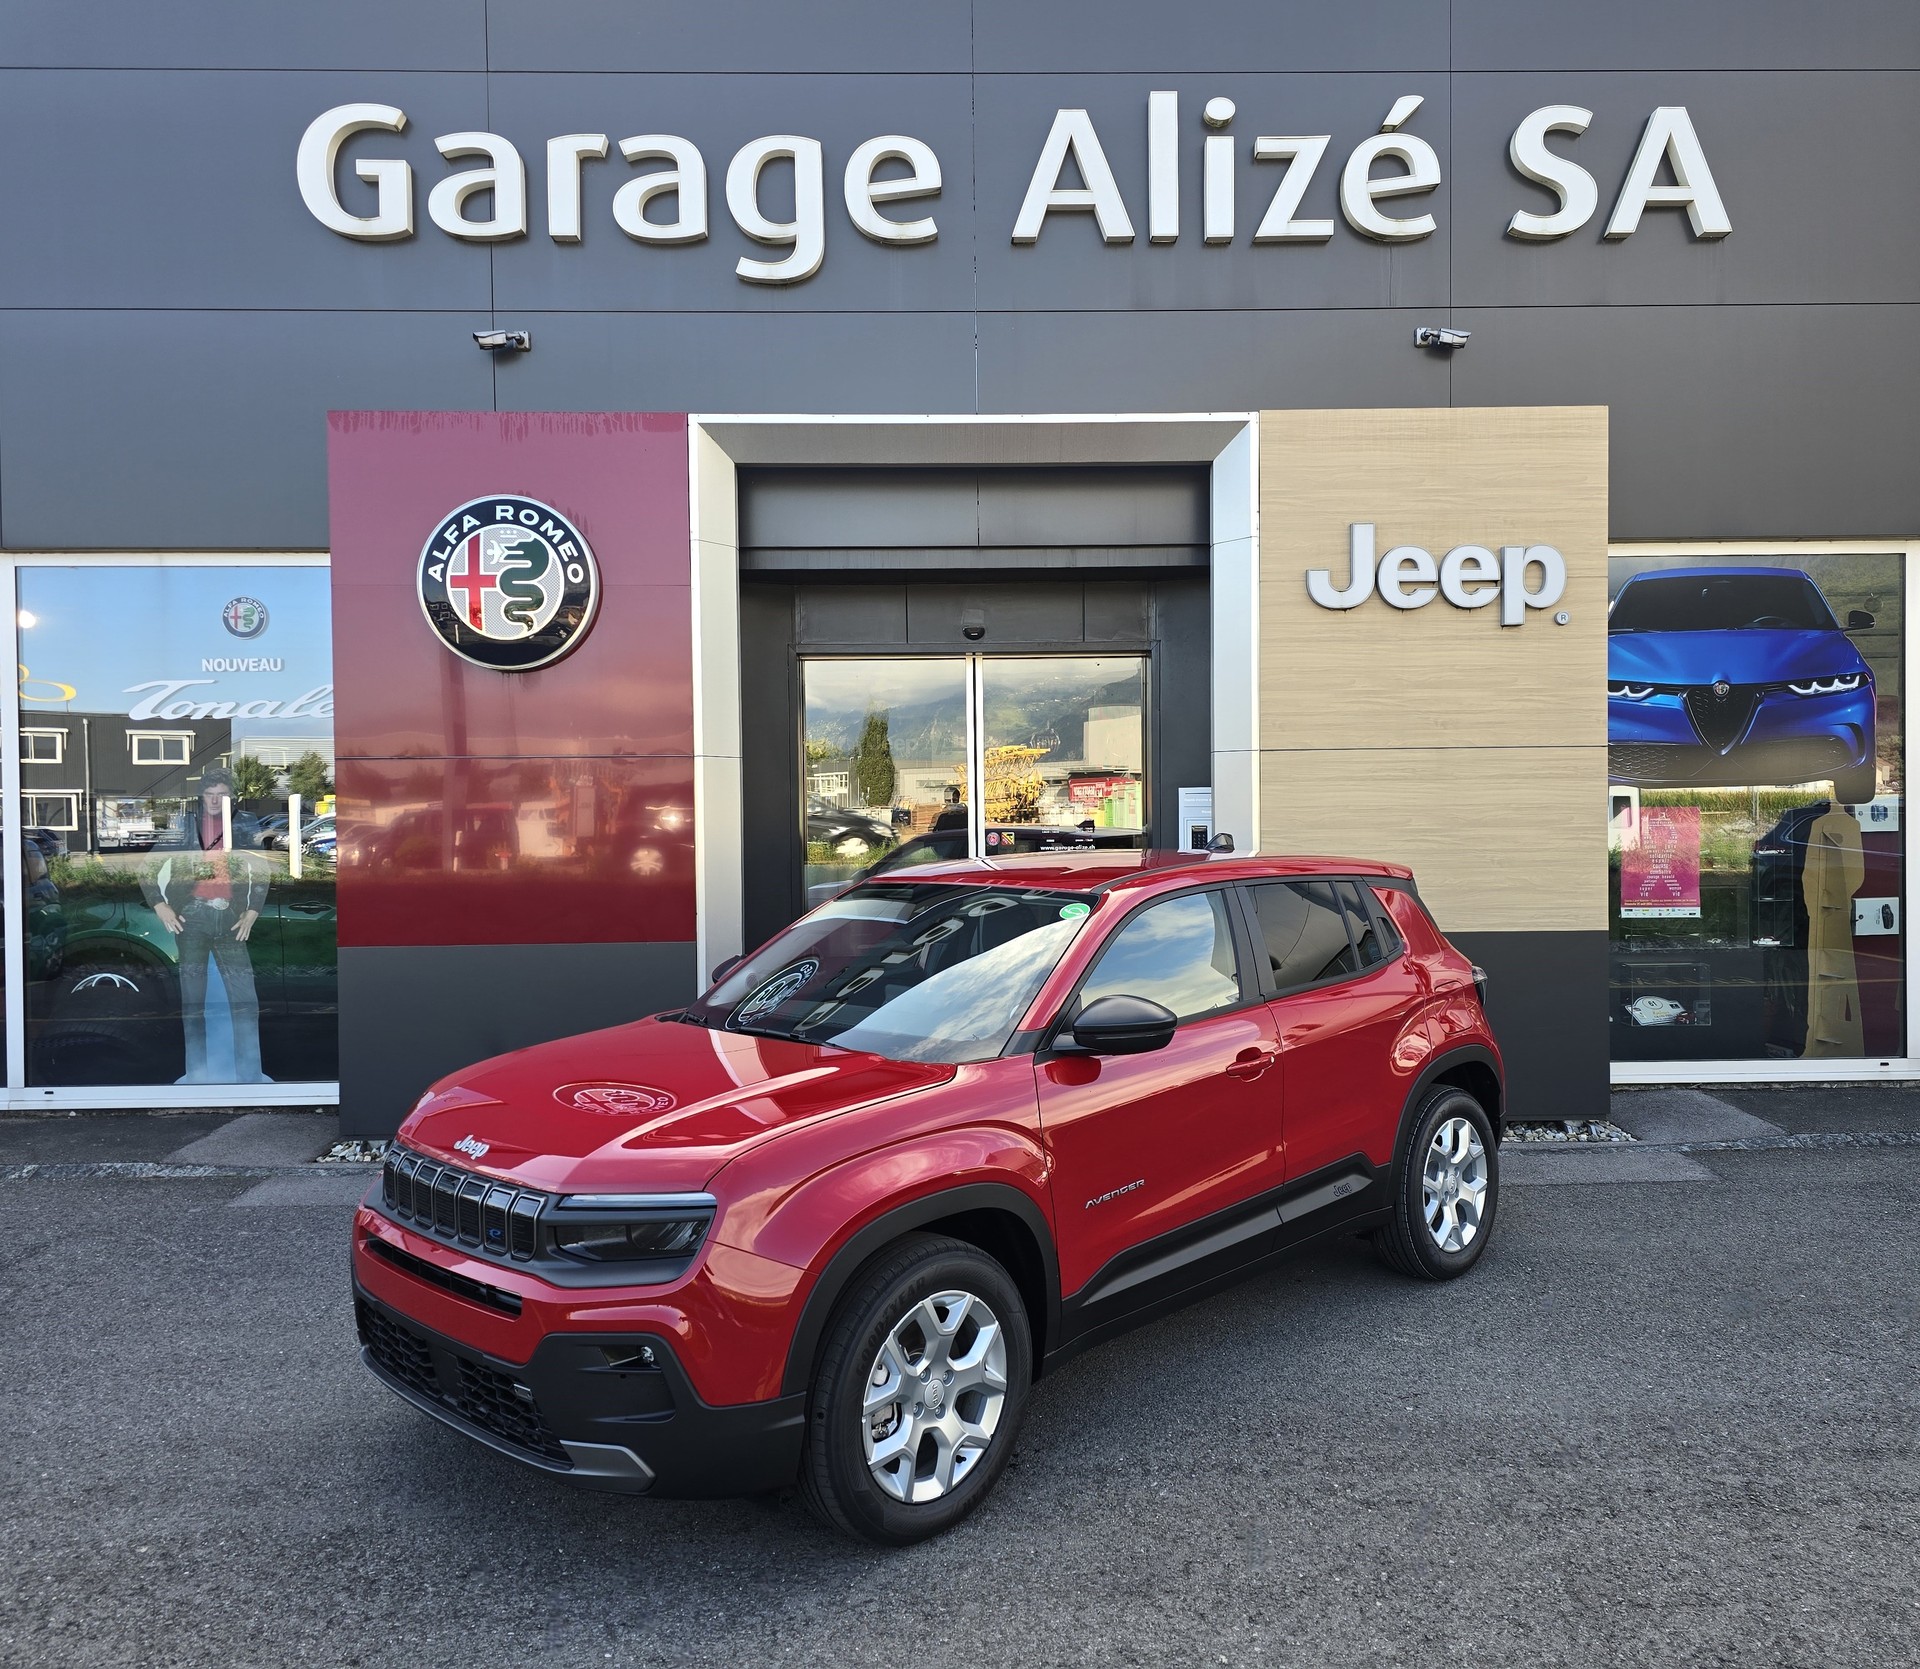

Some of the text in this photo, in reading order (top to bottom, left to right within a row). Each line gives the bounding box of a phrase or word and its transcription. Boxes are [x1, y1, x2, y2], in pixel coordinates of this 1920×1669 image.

[297, 91, 1733, 285] Garage Alizé SA
[428, 505, 584, 584] ALFA ROMEO
[1306, 522, 1567, 626] Jeep
[223, 597, 264, 619] ALFA ROMEO
[201, 657, 283, 672] NOUVEAU
[122, 679, 334, 721] Tonale
[453, 1134, 490, 1160] Jeep
[1085, 1179, 1145, 1209] AVENGER
[1333, 1182, 1352, 1197] Jeep
